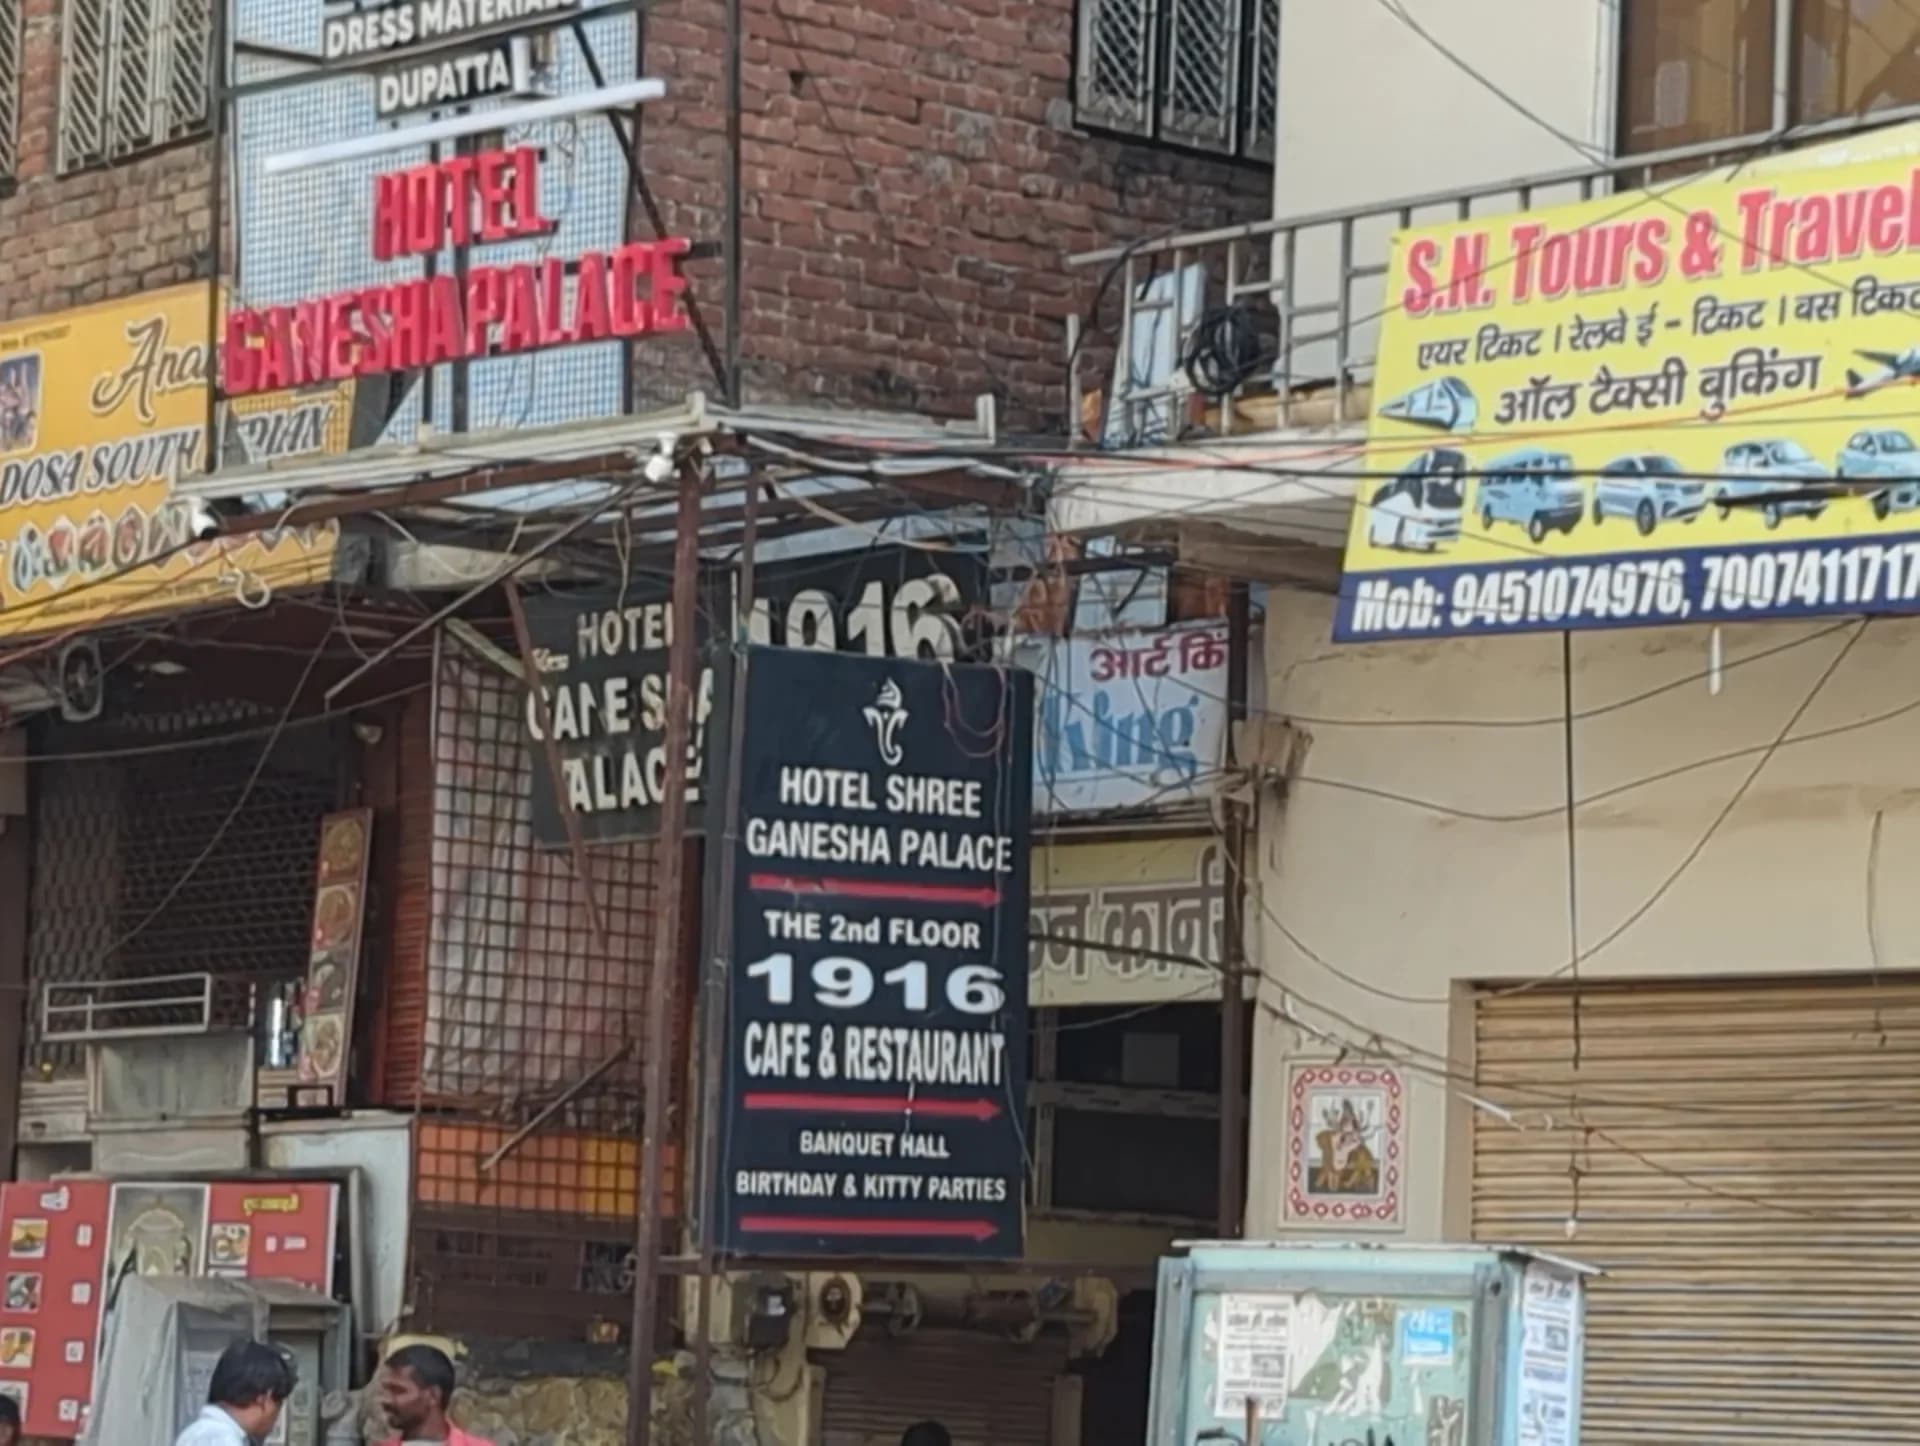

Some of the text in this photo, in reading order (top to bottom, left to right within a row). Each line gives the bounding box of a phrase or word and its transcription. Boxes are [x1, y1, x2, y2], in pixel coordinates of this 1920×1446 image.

[326, 0, 575, 58] DRESS MATER
[379, 48, 510, 112] DUPATTA
[373, 147, 553, 261] HOTEL
[1403, 230, 1493, 316] S.N.
[1511, 217, 1668, 300] Tours
[1678, 208, 1722, 277] &
[224, 237, 690, 394] GANESHA PALACE
[1418, 338, 1469, 370] एयर
[1475, 323, 1543, 362] टिकट
[1569, 308, 1628, 350] रेलवे
[1636, 301, 1660, 347] ई
[1692, 295, 1766, 336] टिकट
[92, 316, 210, 420] Ana
[1494, 375, 1582, 424] ऑल
[1589, 355, 1688, 416] टैक्सी
[86, 428, 201, 488] SOUTH
[1351, 576, 1445, 632] Mob:
[1450, 556, 1691, 627] 9451074976,
[1090, 631, 1228, 682] आर्ट किं
[781, 766, 982, 818] HOTEL SHREE
[746, 817, 1013, 873] GANESHA PALACE
[763, 911, 981, 949] THE 2nd FLOOR
[747, 952, 1006, 1015] 1916
[744, 1020, 1005, 1086] CAFE & RESTAURANT
[799, 1130, 951, 1159] BANQUET HALL
[736, 1170, 1007, 1202] BIRTHDAY & KITTY PARTIES
